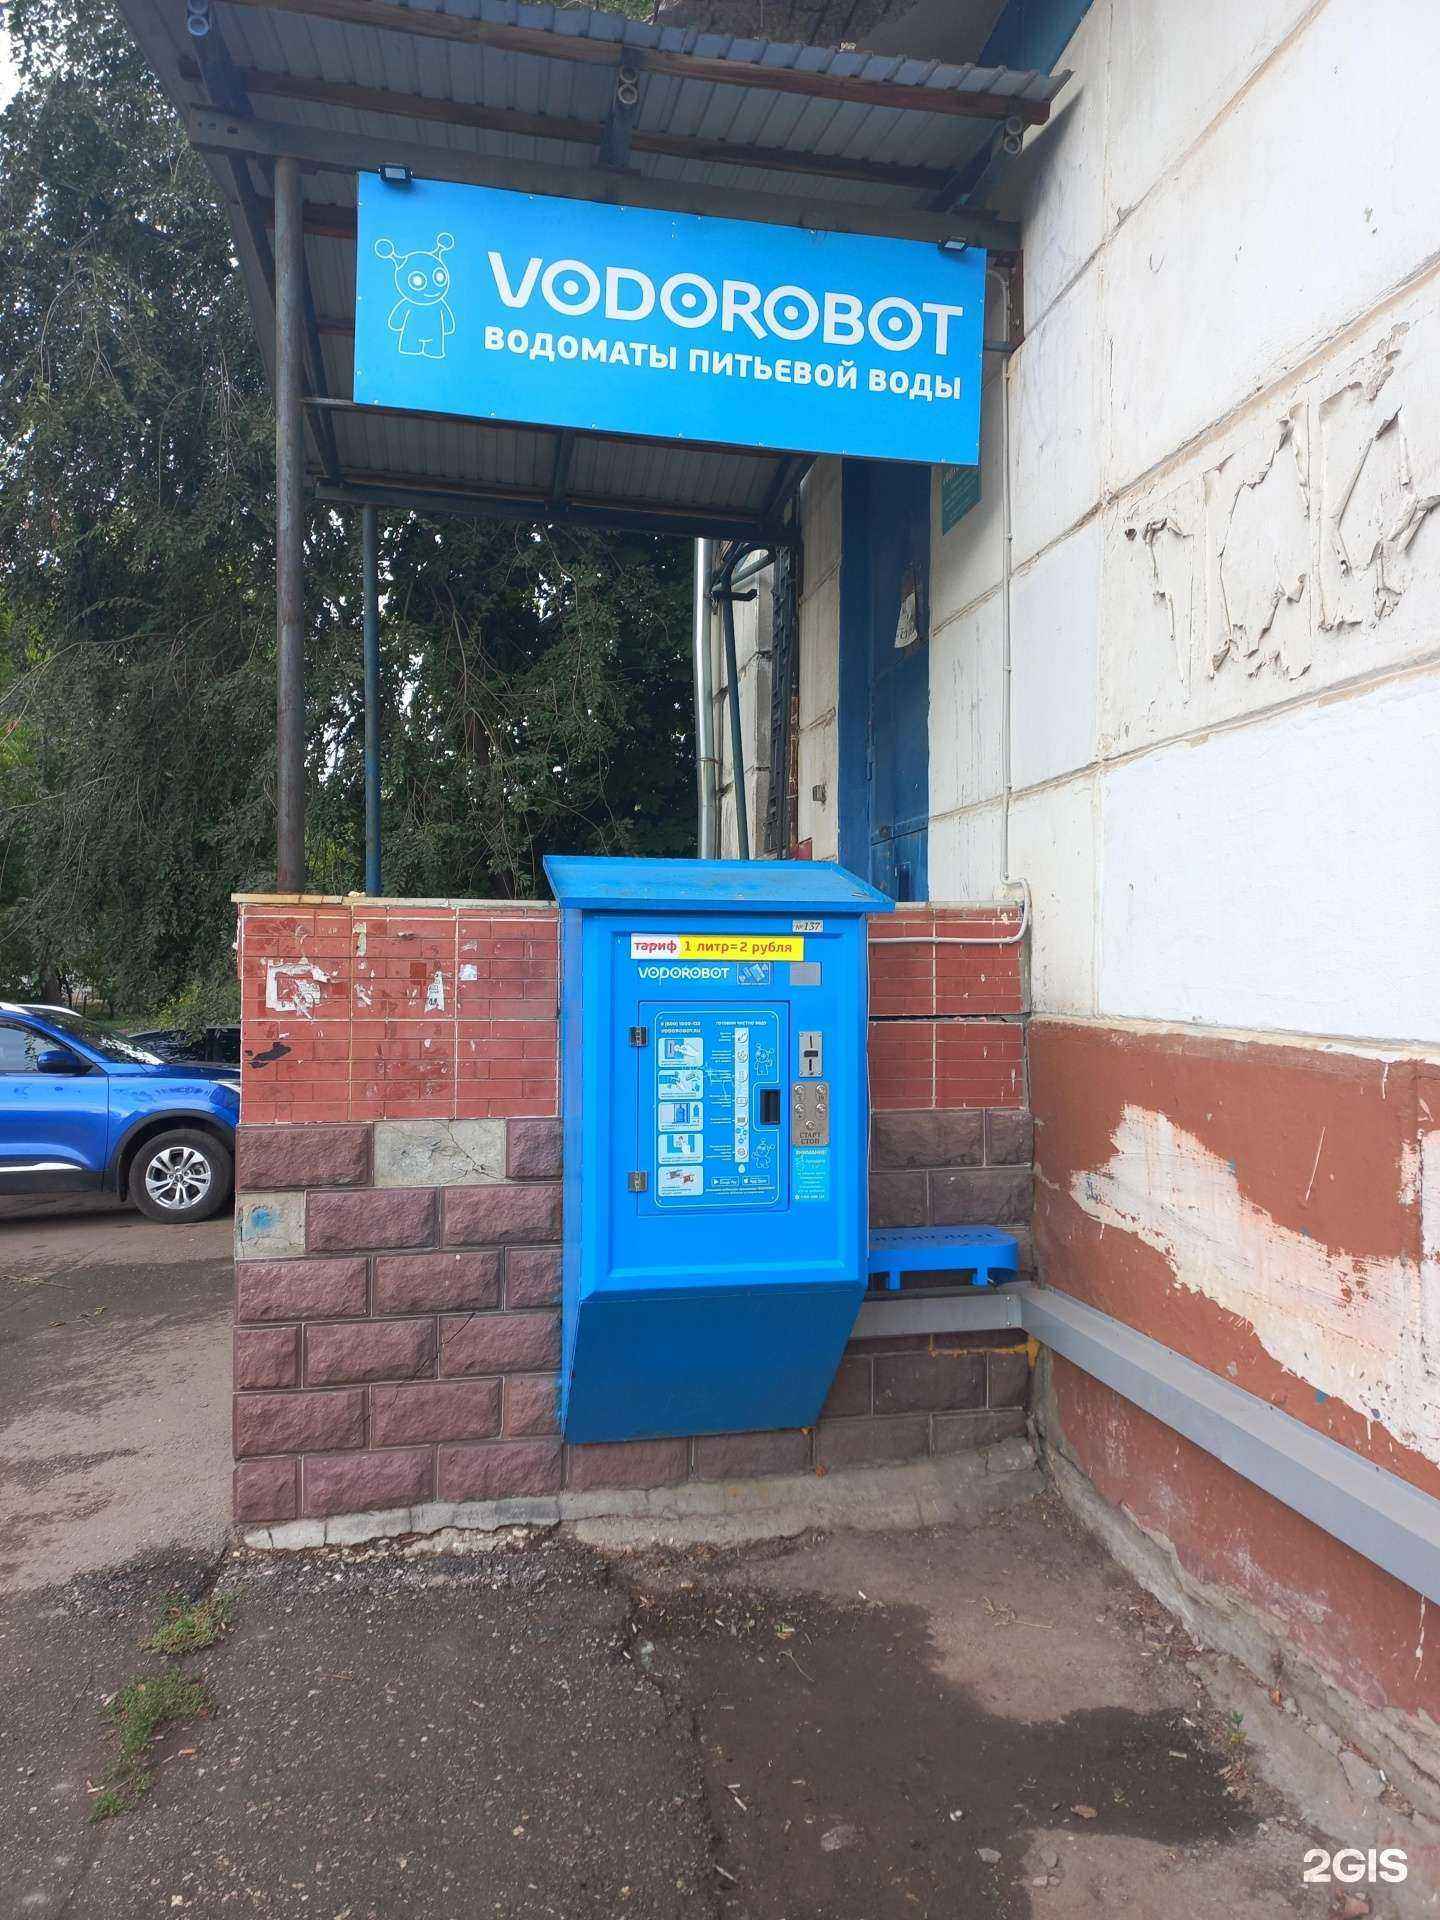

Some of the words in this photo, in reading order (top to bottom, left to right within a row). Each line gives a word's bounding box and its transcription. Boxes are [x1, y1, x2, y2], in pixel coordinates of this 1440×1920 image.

[487, 250, 964, 356] VODOROBOT
[484, 325, 676, 371] ВОДОМАТЫ
[688, 348, 857, 390] ПИТЬЕВОЙ
[868, 367, 961, 402] ВОДЫ
[634, 941, 677, 953] тариф
[684, 941, 691, 951] 1
[752, 941, 792, 954] рубля
[638, 966, 730, 980] VODOROBOT
[799, 1131, 821, 1139] СТАРТ
